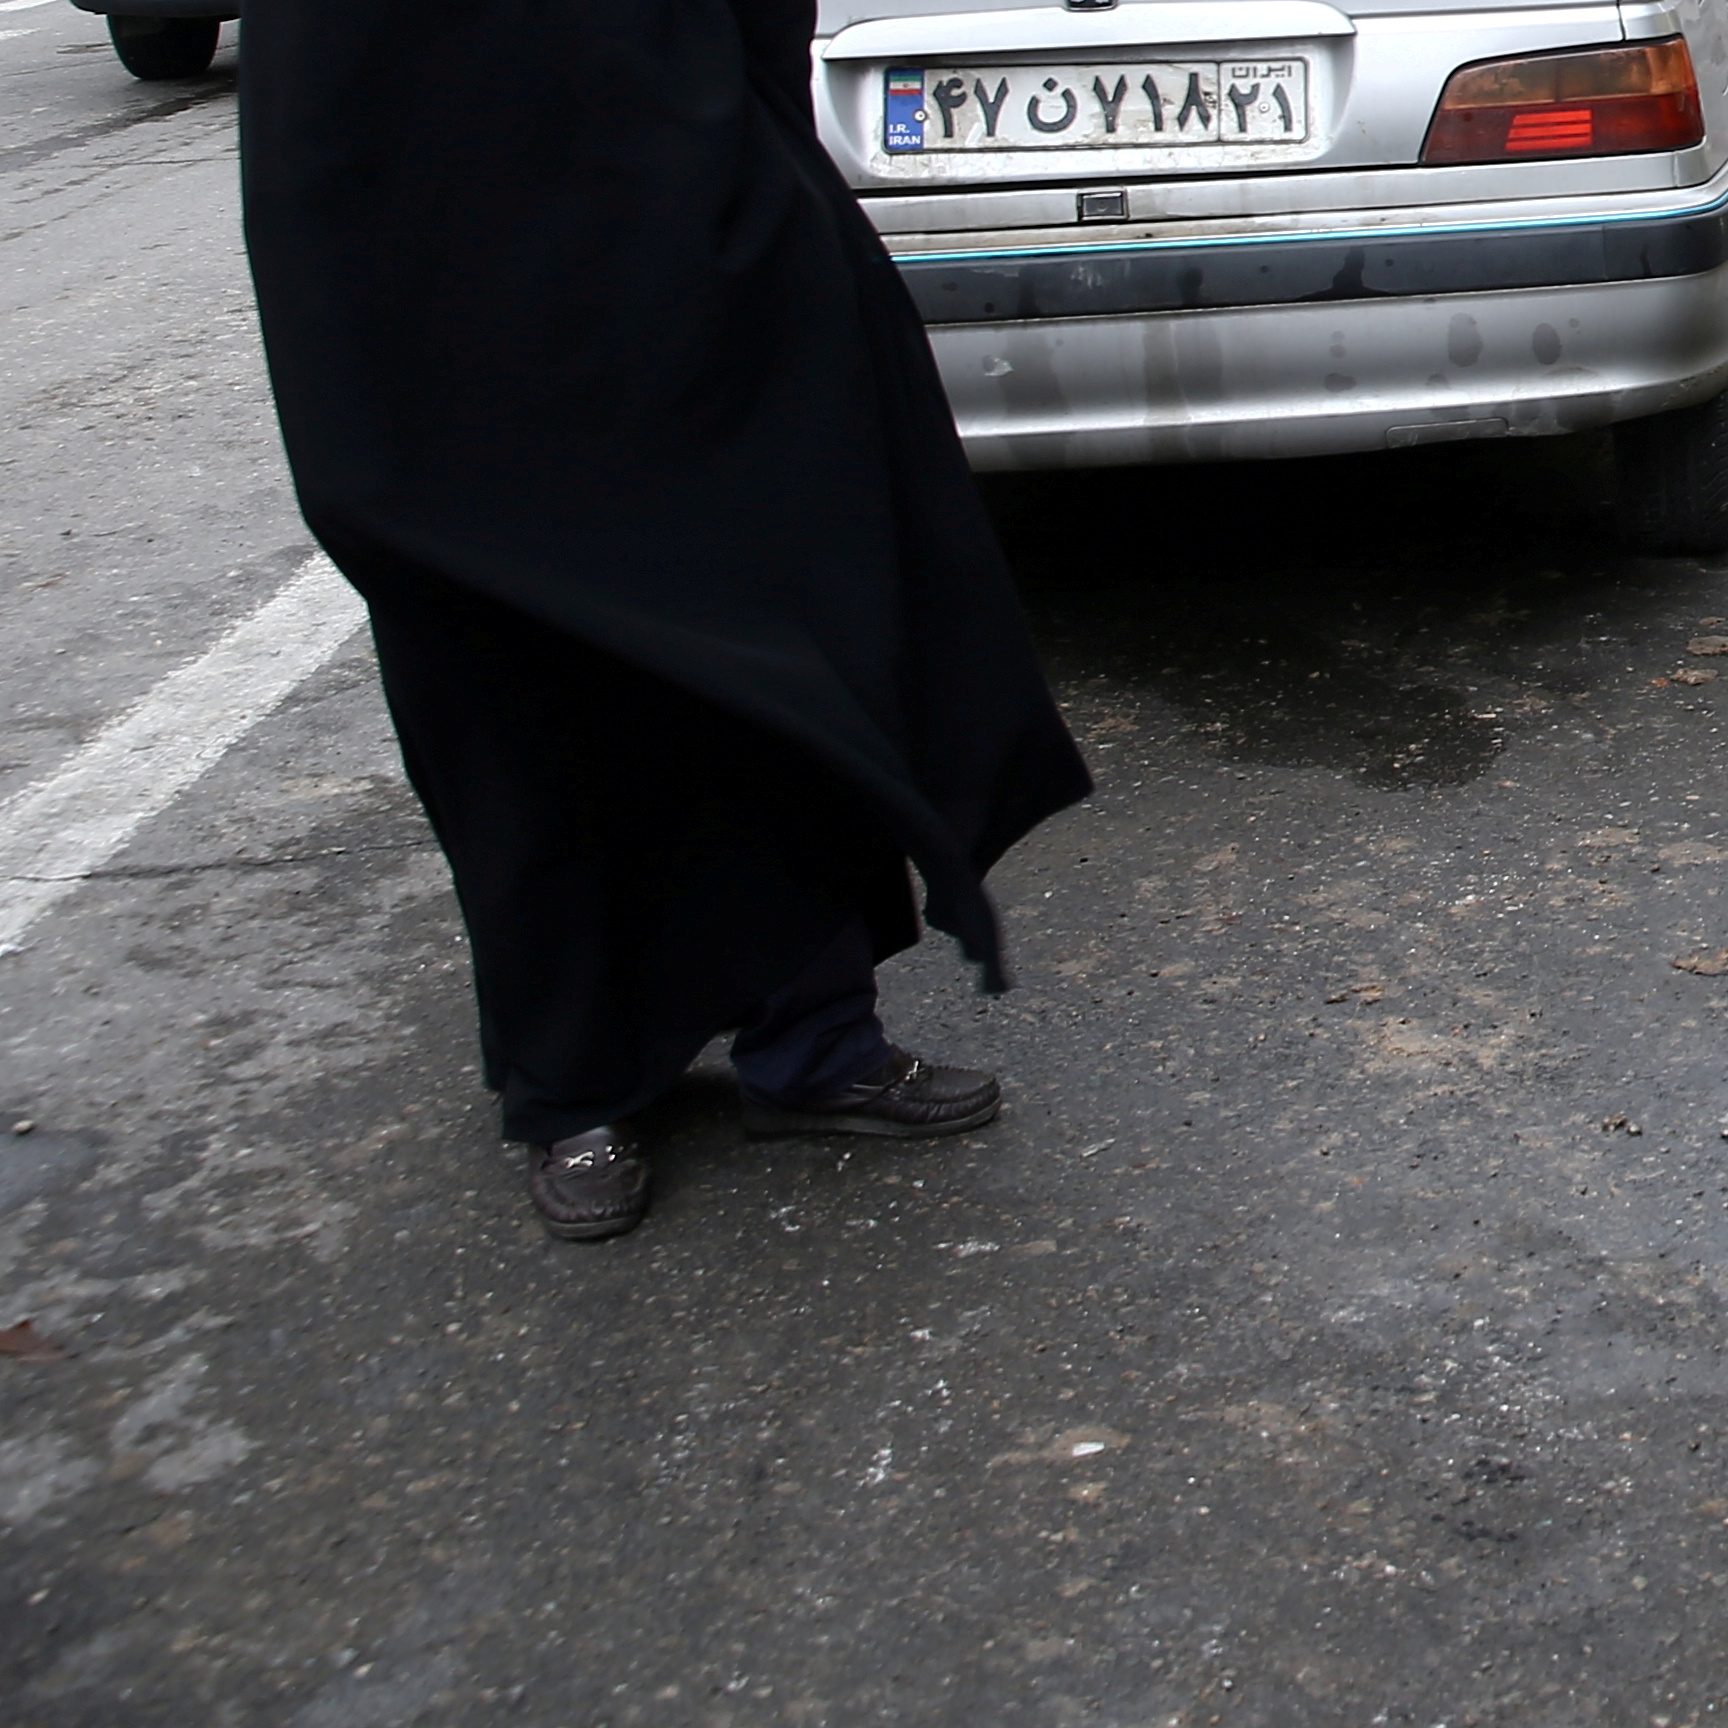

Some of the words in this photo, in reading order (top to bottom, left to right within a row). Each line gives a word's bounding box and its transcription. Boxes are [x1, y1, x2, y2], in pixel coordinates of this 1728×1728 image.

[1231, 65, 1293, 79] ایران
[932, 75, 1010, 138] ۴۷
[1027, 77, 1078, 134] ن
[1093, 72, 1213, 134] ۷۱۸
[1228, 82, 1293, 134] ۲۱
[888, 125, 911, 135] I.R.
[888, 135, 922, 146] IRAN
